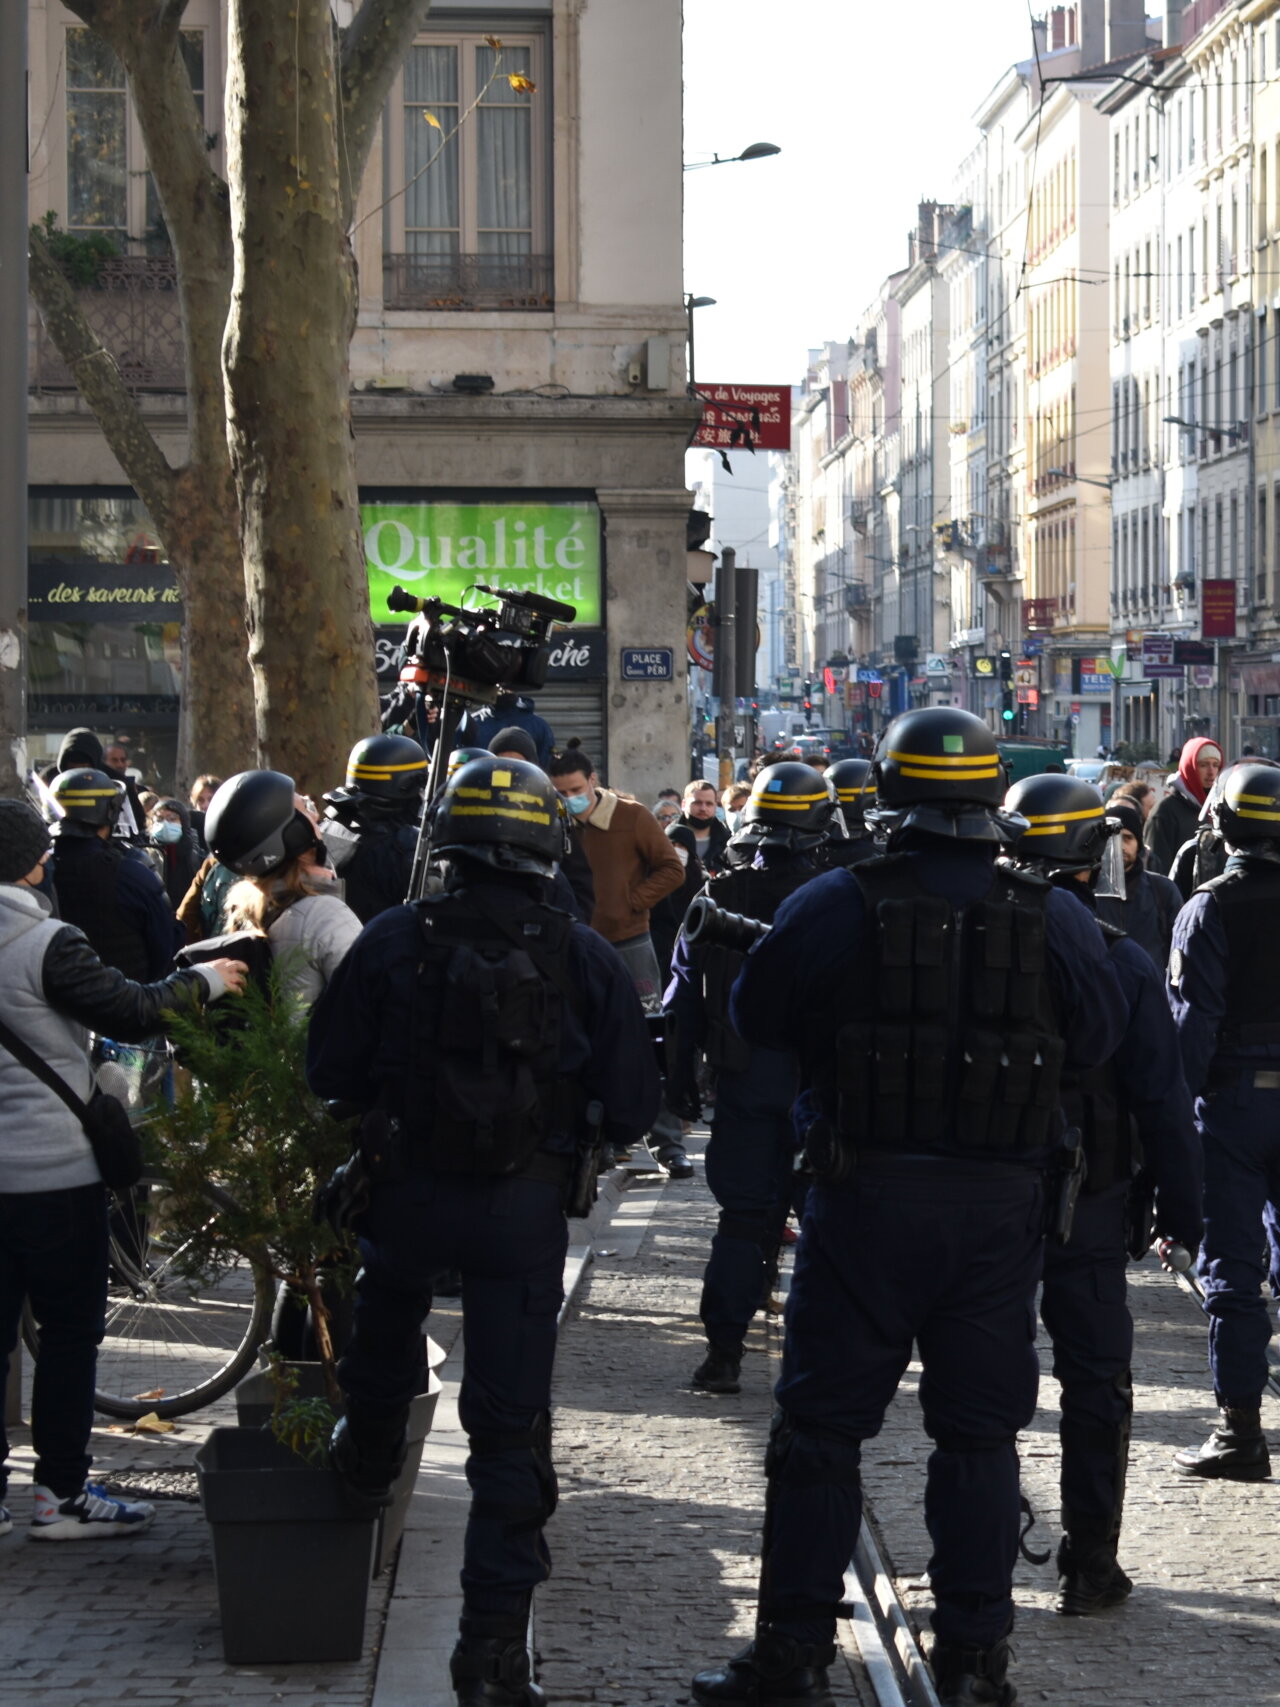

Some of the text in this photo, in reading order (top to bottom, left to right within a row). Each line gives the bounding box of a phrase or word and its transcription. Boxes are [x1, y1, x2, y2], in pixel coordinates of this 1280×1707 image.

[715, 386, 728, 400] de
[732, 386, 780, 406] Voyages
[364, 516, 585, 581] Qualité
[48, 582, 83, 603] des
[86, 586, 159, 603] saveurs
[632, 654, 661, 664] PLACE
